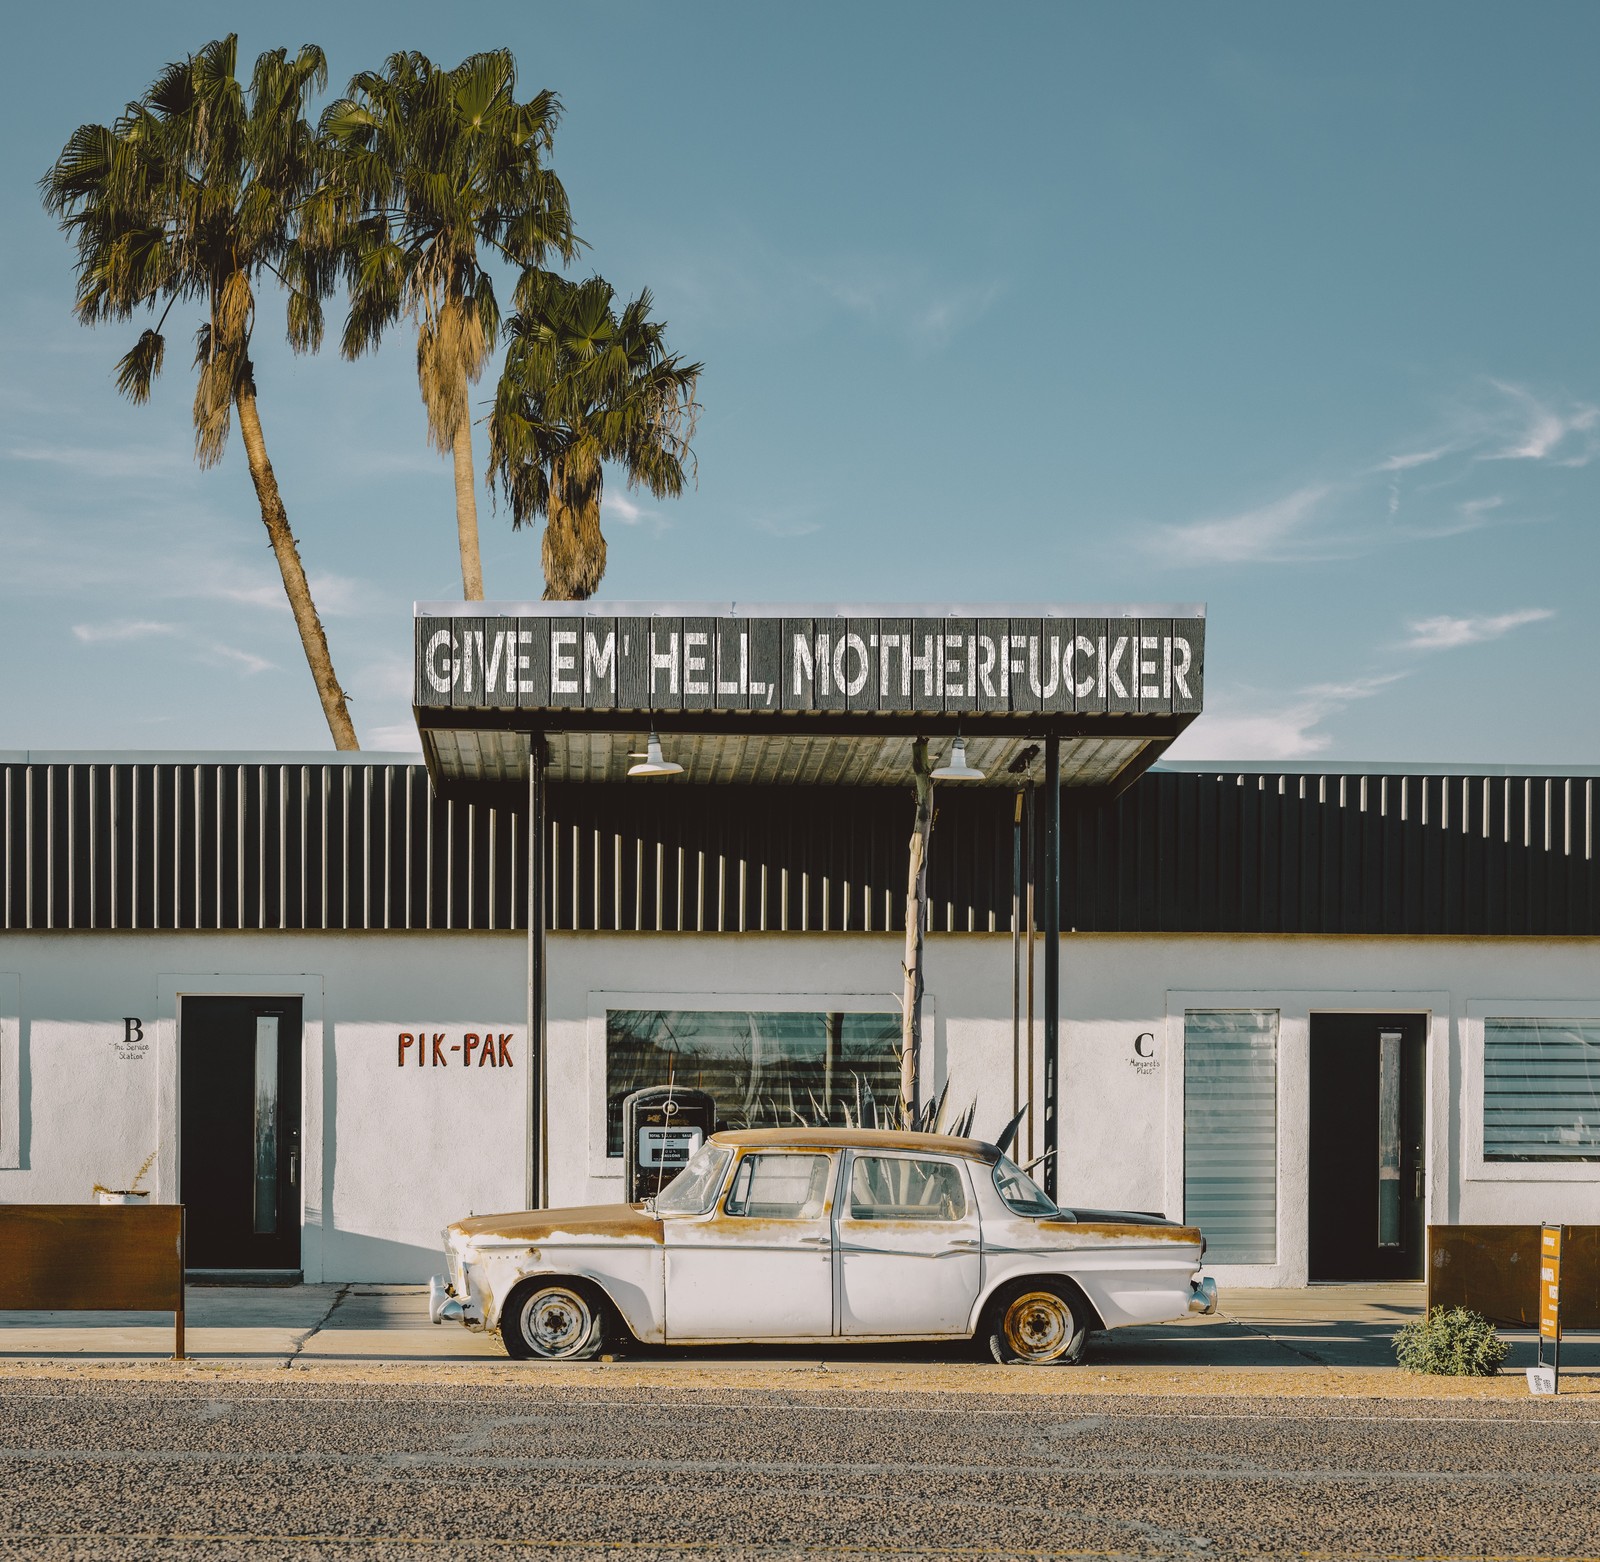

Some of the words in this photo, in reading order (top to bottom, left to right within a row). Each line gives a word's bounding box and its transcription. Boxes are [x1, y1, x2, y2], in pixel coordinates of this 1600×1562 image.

[425, 629, 534, 694] GIVE
[551, 631, 630, 694] EM'
[647, 632, 775, 706] HELL,
[793, 633, 1193, 700] MOTHERFUCKER
[122, 1017, 144, 1042] B
[126, 1042, 150, 1051] Service
[398, 1032, 514, 1068] PIK-PAK
[1134, 1032, 1155, 1058] C
